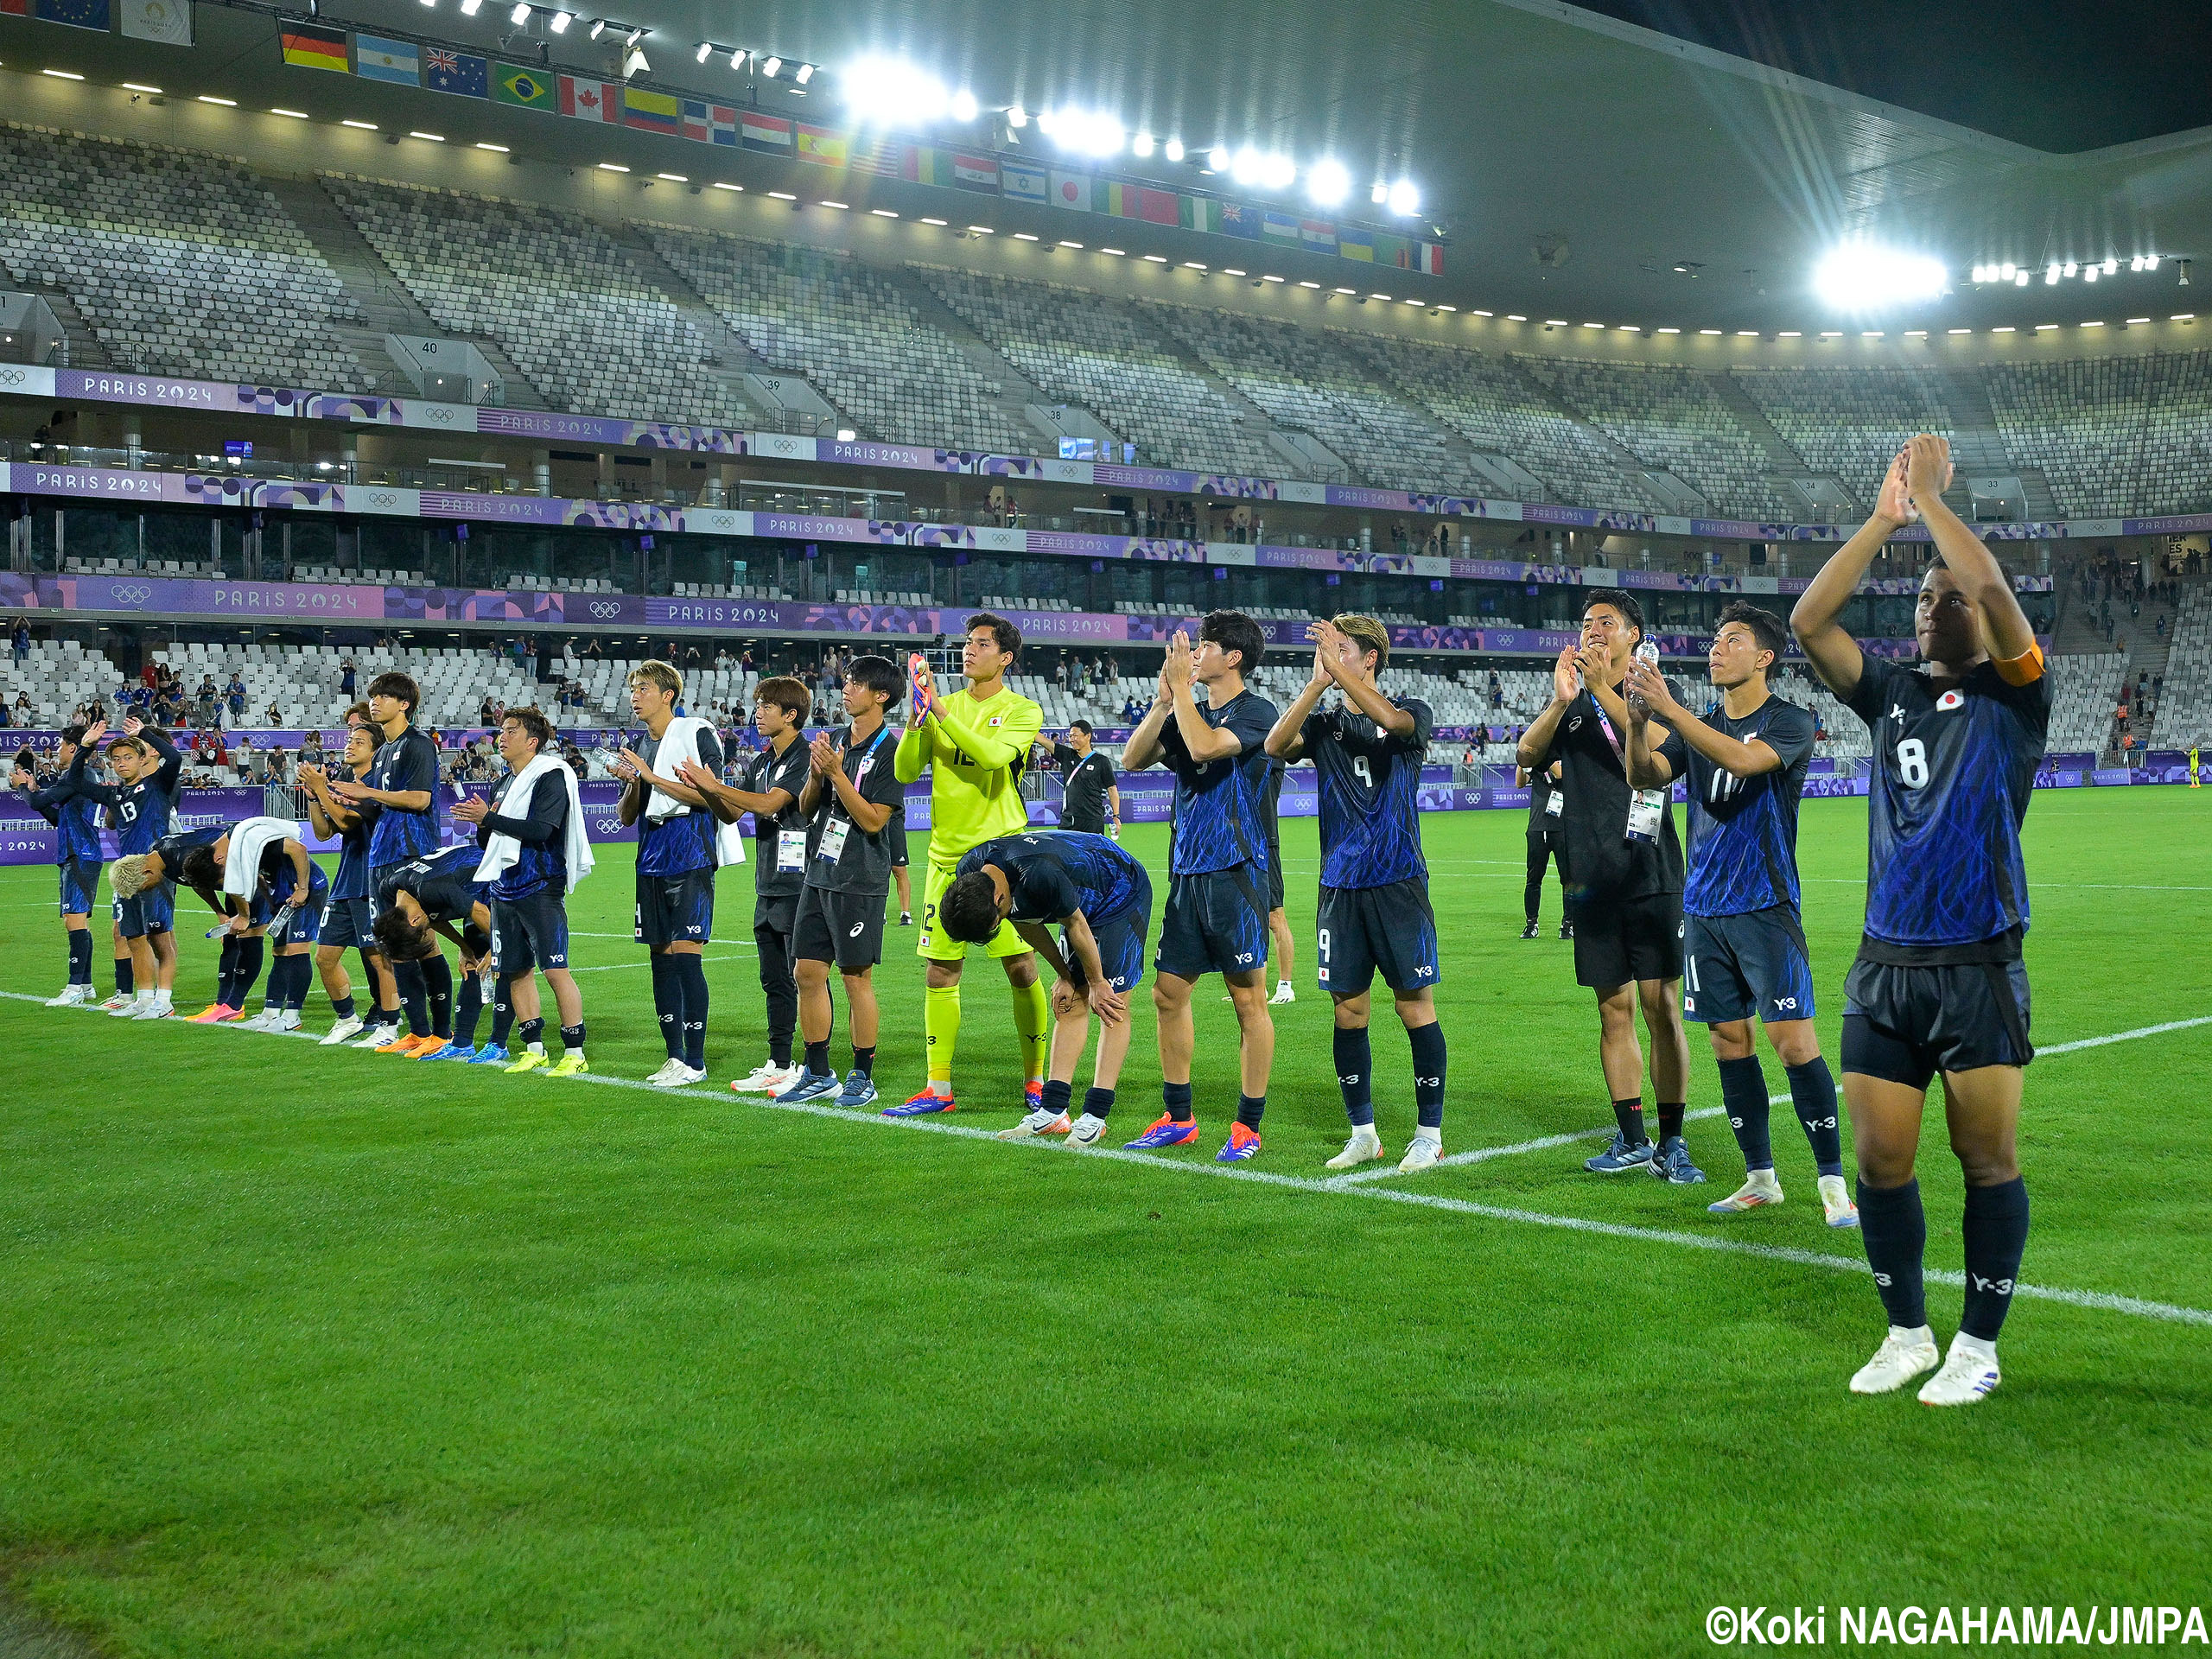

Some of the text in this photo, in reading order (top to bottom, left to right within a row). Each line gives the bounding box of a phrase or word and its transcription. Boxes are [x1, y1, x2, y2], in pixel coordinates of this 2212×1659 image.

[422, 342, 437, 354] 40
[85, 378, 212, 402] PARIS 2024
[767, 380, 780, 391] 39
[1050, 410, 1061, 421] 38
[500, 416, 602, 435] PARIS 2024
[835, 445, 918, 464] PARIS 2024
[36, 473, 162, 493] PARIS 2024
[1109, 470, 1144, 483] PARIS
[1338, 491, 1369, 503] PARIS
[441, 499, 543, 517] PARIS 2024
[770, 519, 854, 535] PARIS 2024
[2138, 520, 2173, 530] PARIS
[1040, 537, 1075, 550] PARIS
[214, 590, 358, 609] PARIS 2024
[669, 606, 779, 623] PARIS 2024
[1022, 618, 1112, 633] PARIS 2024
[1354, 755, 1373, 788] 9
[1897, 738, 1929, 790] 8
[119, 801, 137, 823] 13
[8, 841, 46, 851] 2024
[921, 903, 936, 932] 12
[686, 925, 702, 934] Y-3
[1319, 929, 1332, 963] 9
[550, 954, 564, 963] Y-3
[1235, 952, 1254, 964] Y-3
[1414, 965, 1433, 977] Y-3
[1774, 997, 1797, 1011] Y-3
[683, 1021, 703, 1031] Y-3
[1414, 1077, 1440, 1087] Y-3
[1806, 1116, 1836, 1132] Y-3
[1972, 1272, 2014, 1295] Y-3
